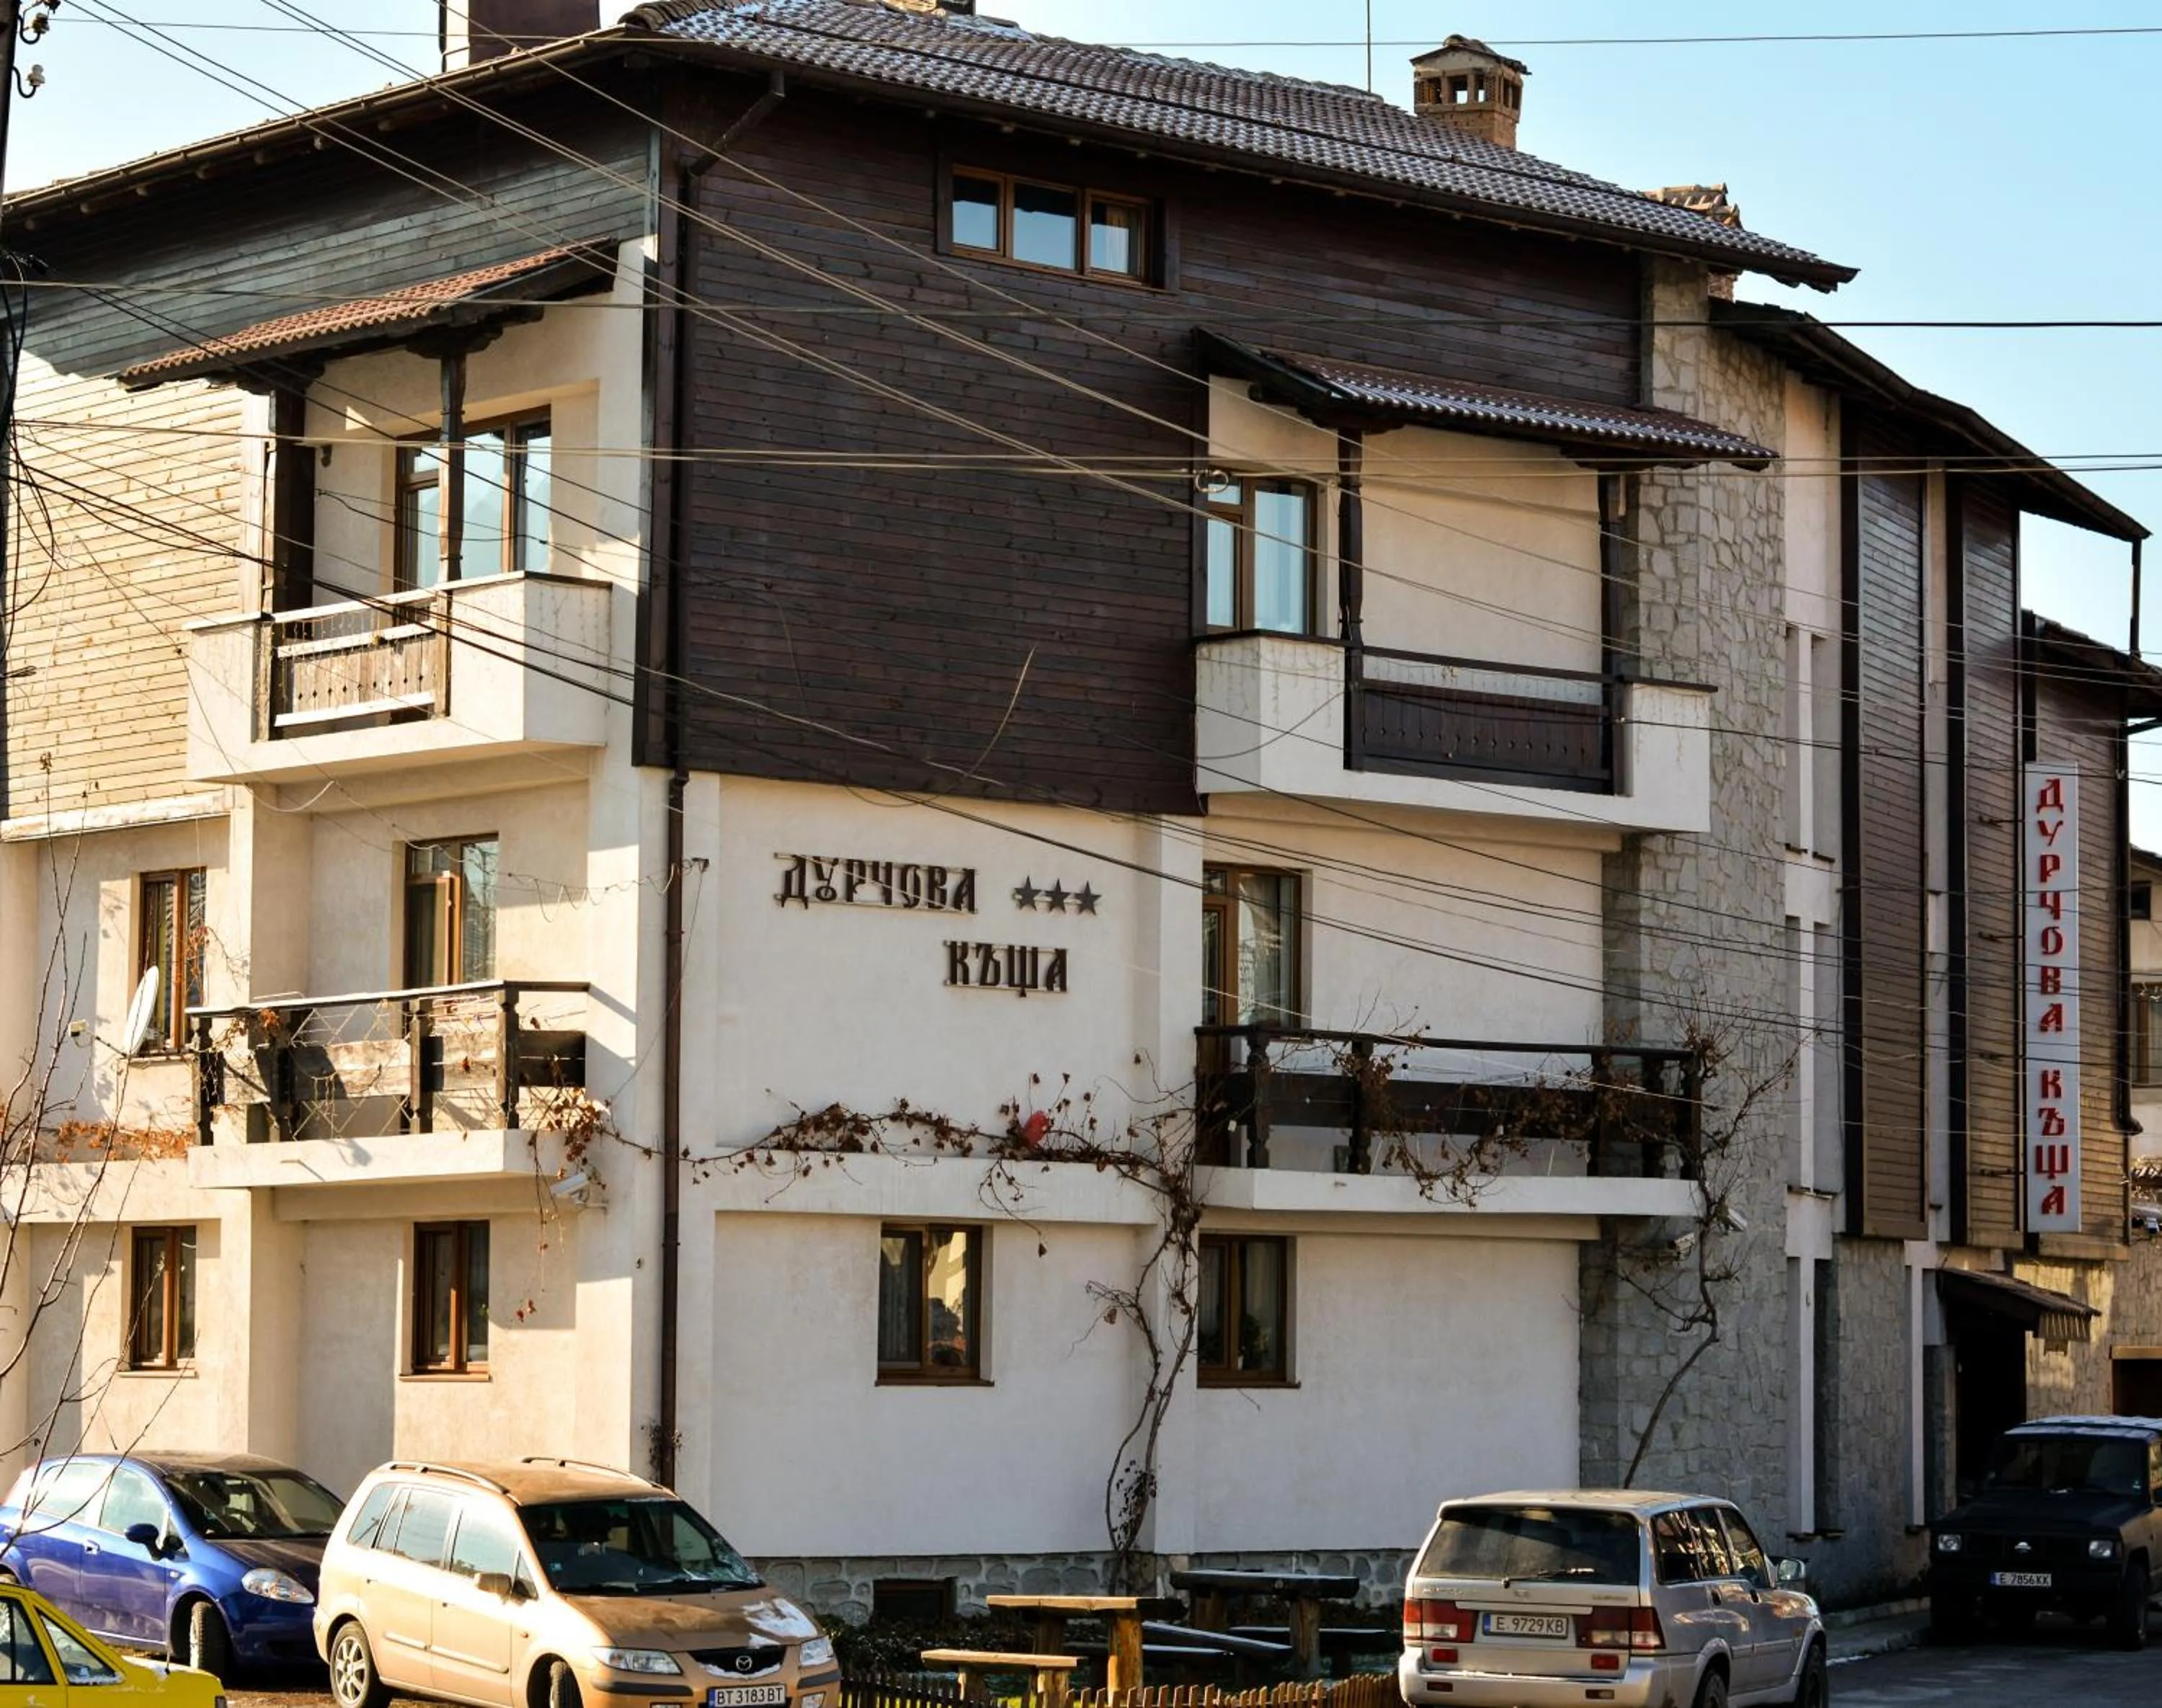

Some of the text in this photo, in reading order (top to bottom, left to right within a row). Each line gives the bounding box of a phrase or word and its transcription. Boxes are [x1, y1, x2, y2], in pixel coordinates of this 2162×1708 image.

[780, 855, 975, 912] ДУРЧОВА
[949, 941, 1067, 997] КЪЩА
[2035, 778, 2069, 1215] ДУРЧОВА КЪЩА
[1497, 1616, 1505, 1630] E
[736, 1689, 765, 1704] 3183
